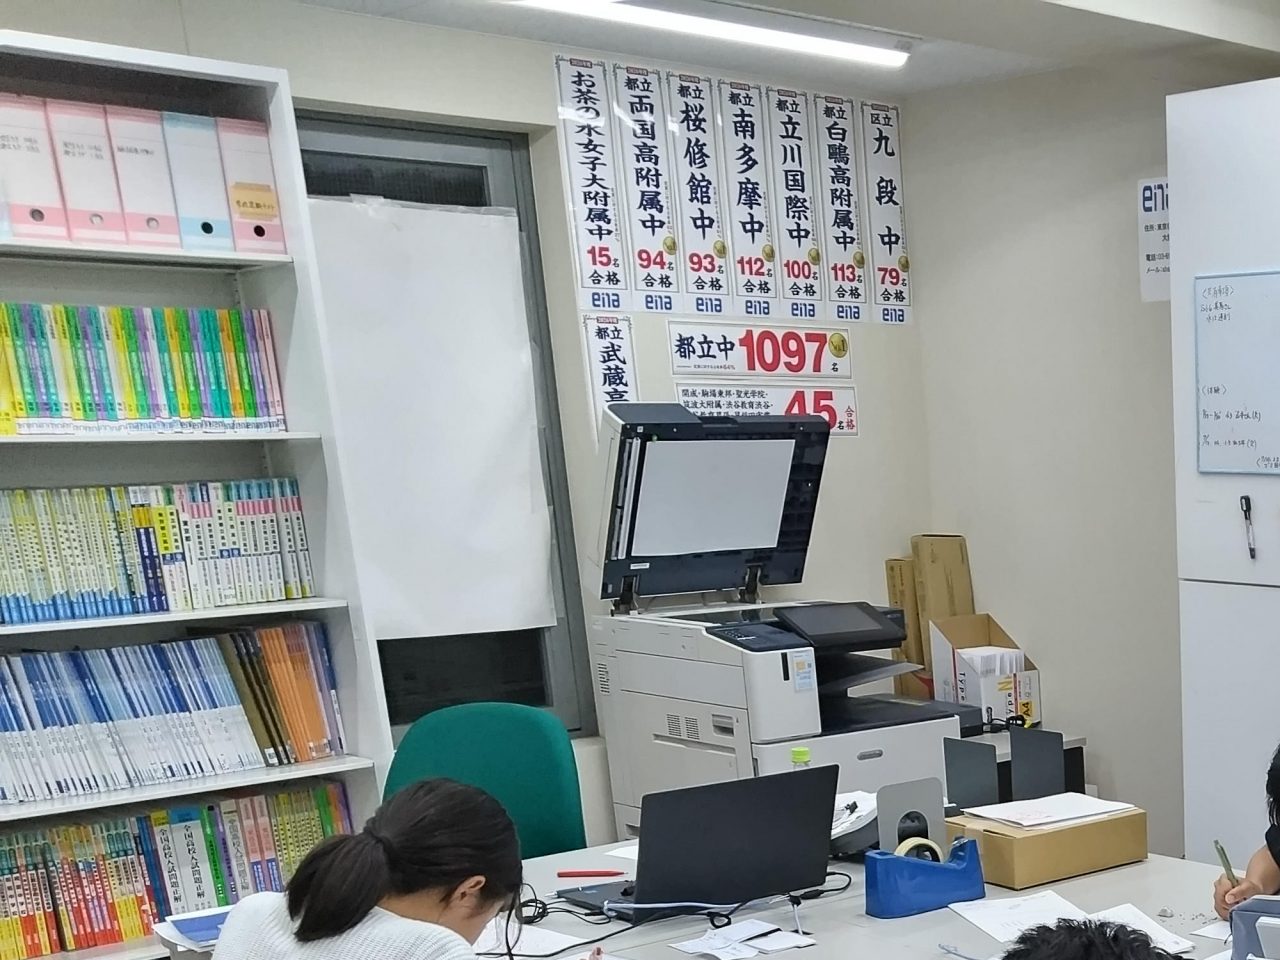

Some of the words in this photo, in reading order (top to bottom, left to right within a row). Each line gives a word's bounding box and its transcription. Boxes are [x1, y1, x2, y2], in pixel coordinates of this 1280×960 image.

[624, 76, 654, 93] 都立
[677, 83, 705, 100] 都立
[728, 91, 755, 107] 都立
[776, 98, 801, 114] 都立
[823, 105, 847, 120] 都立
[870, 113, 893, 127] 区立
[571, 71, 614, 241] お茶の水女子大附属中
[628, 94, 665, 237] 両国高附属中
[679, 101, 715, 240] 桜修館中
[732, 108, 764, 244] 南多摩中
[779, 115, 811, 248] 立川国際中
[1143, 183, 1169, 213] en
[588, 270, 621, 286] 合格
[642, 272, 673, 288] 合格
[693, 275, 724, 291] 合格
[743, 279, 771, 294] 合格
[789, 282, 816, 297] 合格
[835, 285, 861, 300] 合格
[592, 292, 620, 309] ena
[645, 294, 672, 310] ena
[880, 288, 906, 303] 合格
[696, 297, 722, 313] ena
[745, 300, 770, 315] ena
[791, 303, 815, 318] ena
[837, 305, 860, 320] ena
[883, 308, 904, 323] ena
[595, 325, 624, 340] 都立
[845, 405, 856, 431] 合格
